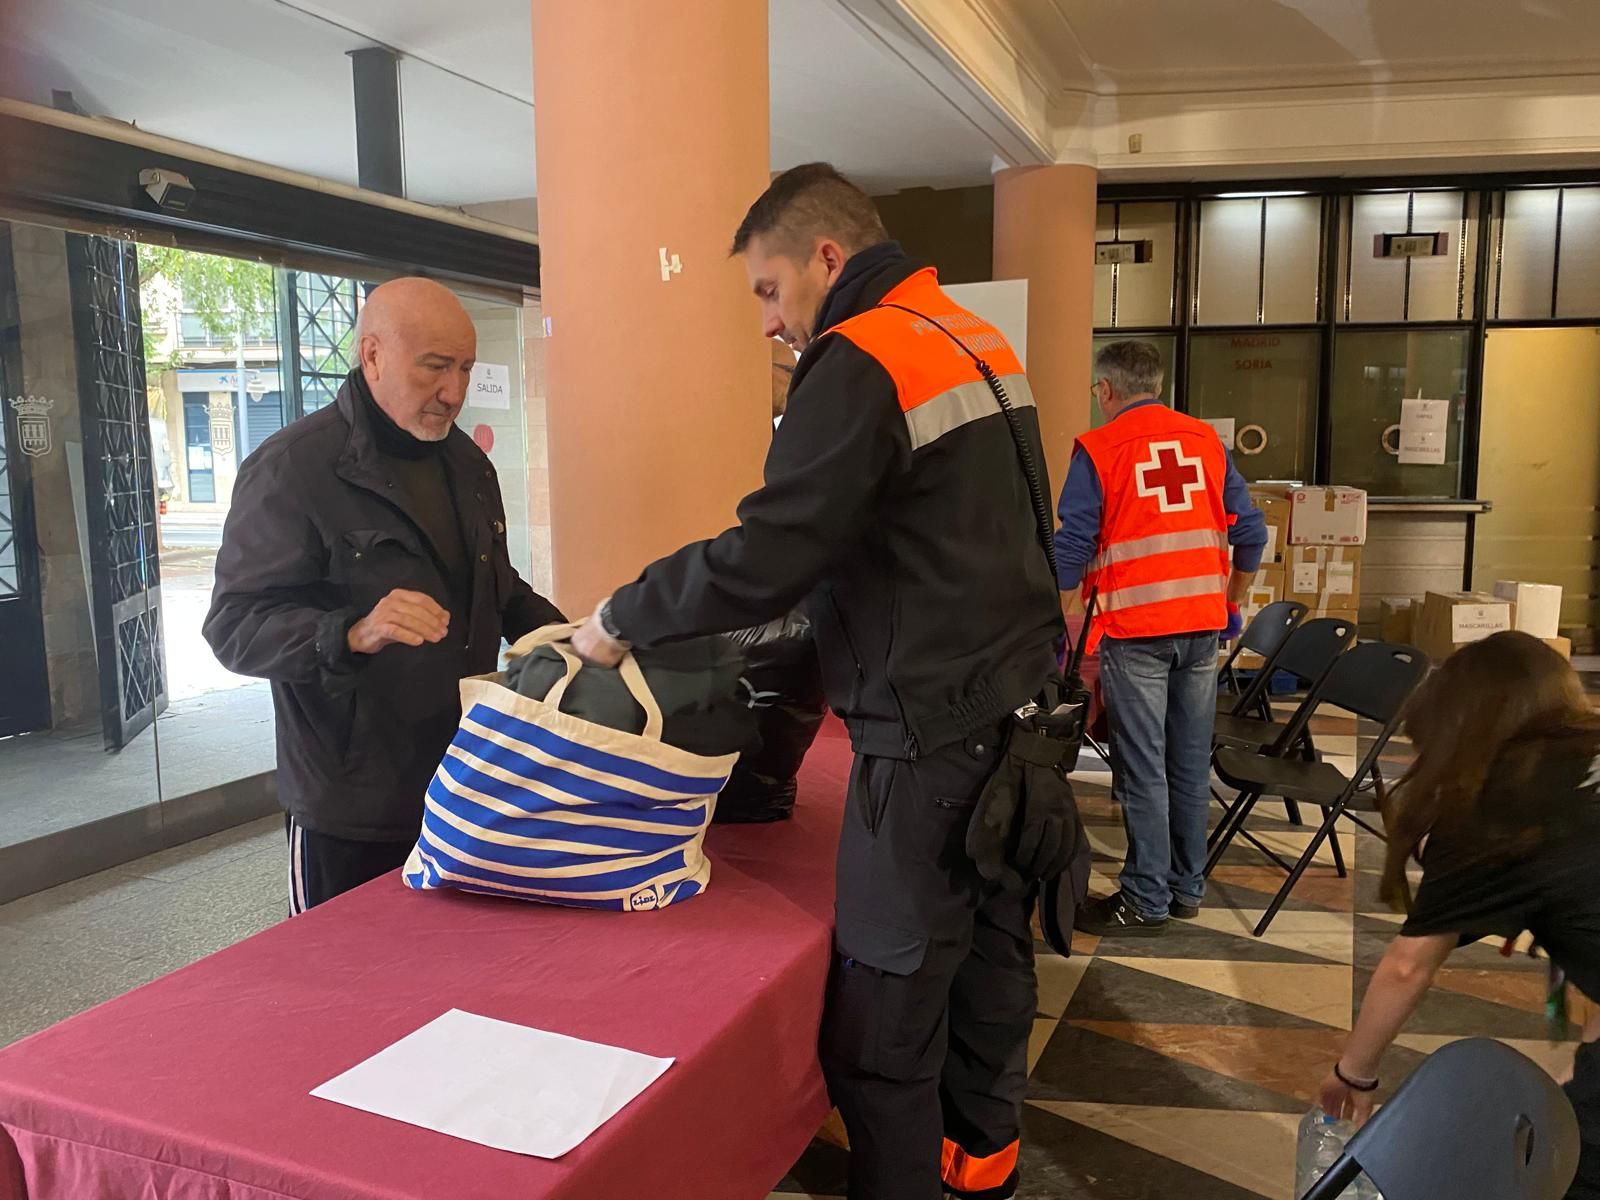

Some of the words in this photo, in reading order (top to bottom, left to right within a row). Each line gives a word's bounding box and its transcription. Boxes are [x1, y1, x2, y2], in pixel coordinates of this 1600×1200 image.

[1231, 337, 1280, 348] MADRID
[1235, 359, 1272, 369] SORIA
[476, 383, 503, 395] SALIDA
